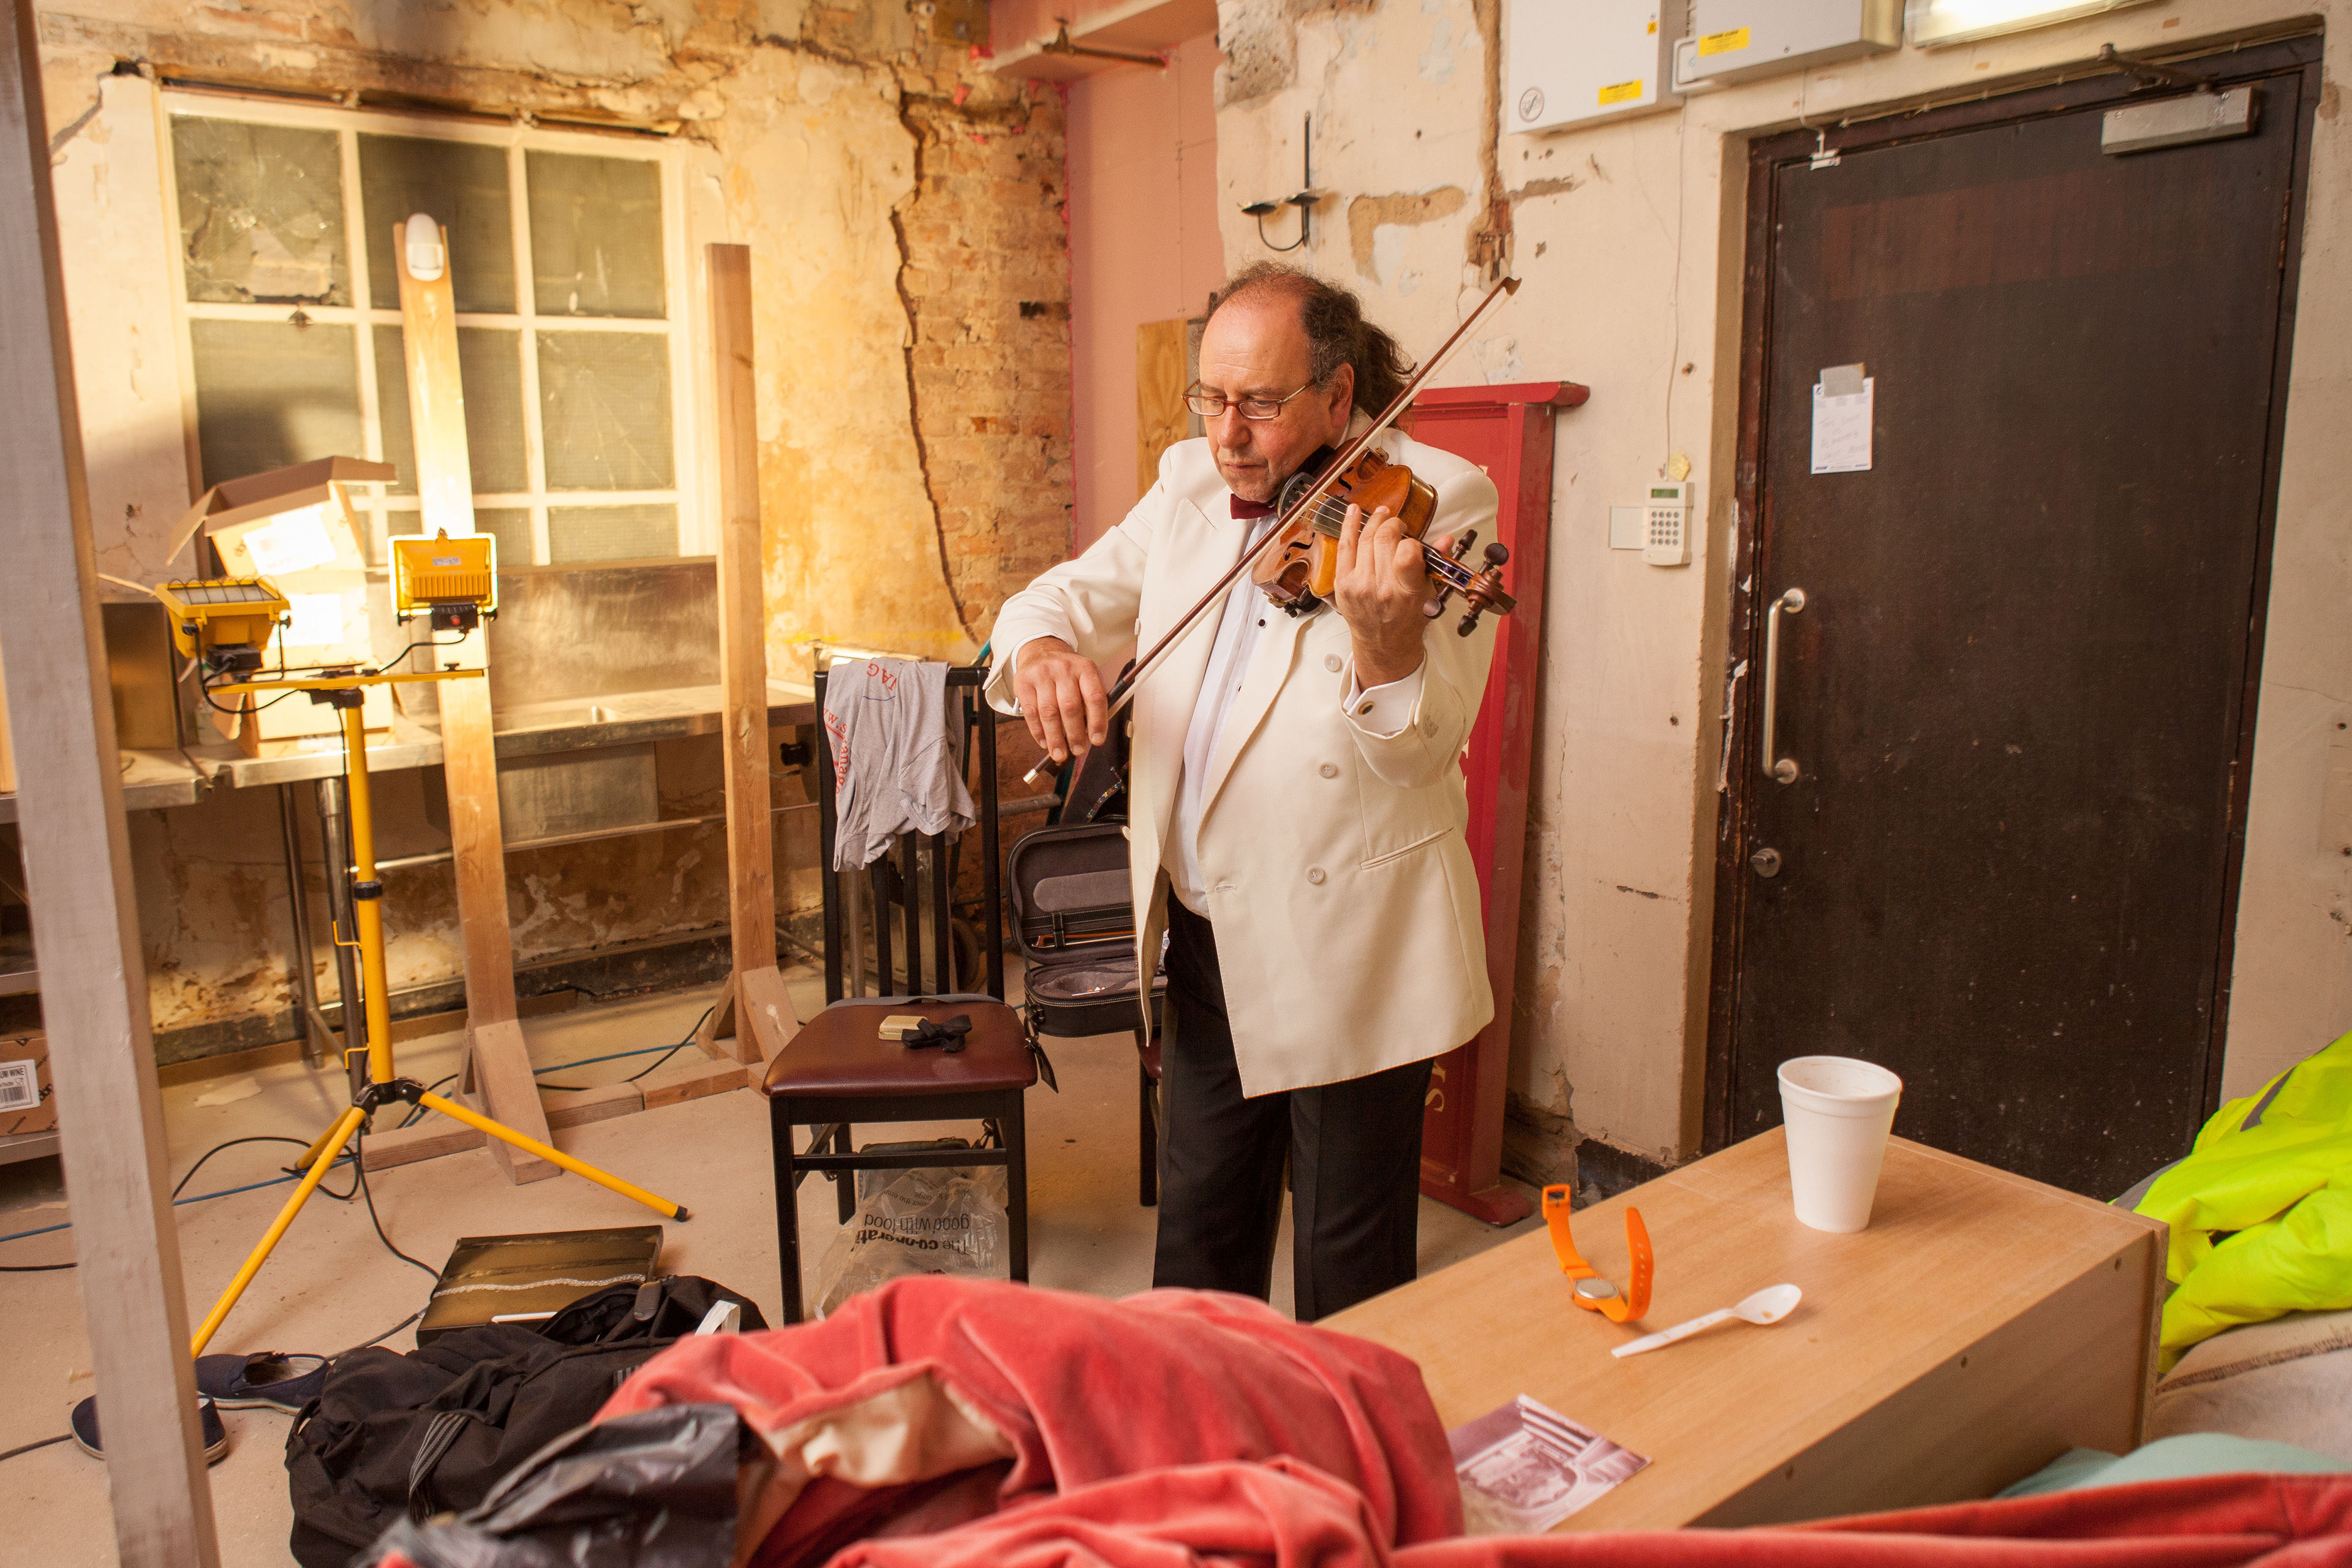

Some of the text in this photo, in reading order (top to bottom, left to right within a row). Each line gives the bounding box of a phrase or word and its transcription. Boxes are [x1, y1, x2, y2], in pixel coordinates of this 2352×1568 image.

[10, 1068, 25, 1077] WINE
[864, 1213, 970, 1235] good with food
[943, 1239, 971, 1256] The
